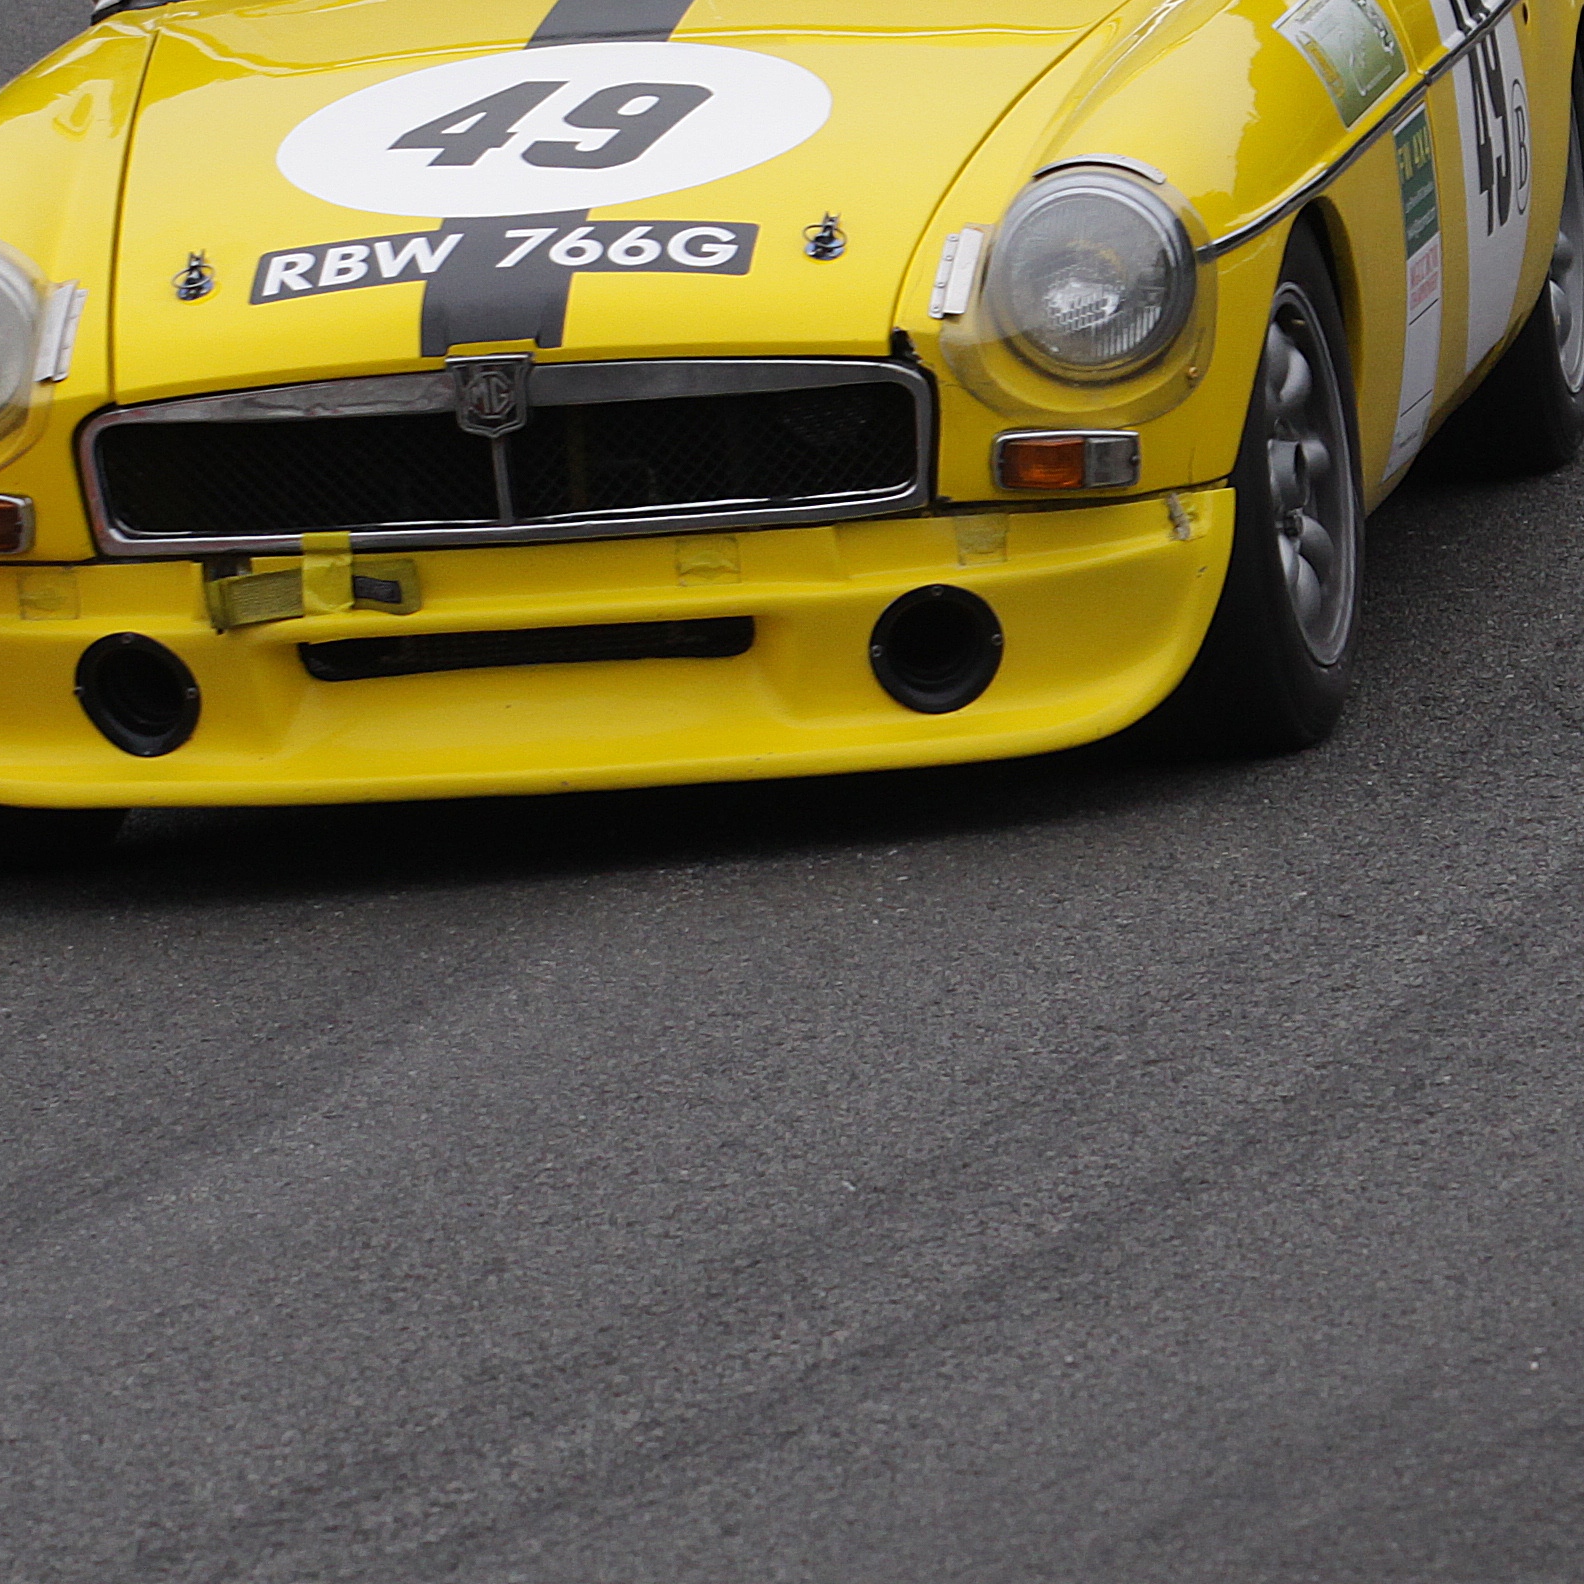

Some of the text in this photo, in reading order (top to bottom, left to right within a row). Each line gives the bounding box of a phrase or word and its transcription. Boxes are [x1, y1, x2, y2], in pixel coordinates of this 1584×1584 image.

[387, 80, 714, 169] 49
[261, 226, 739, 296] RBW 766G
